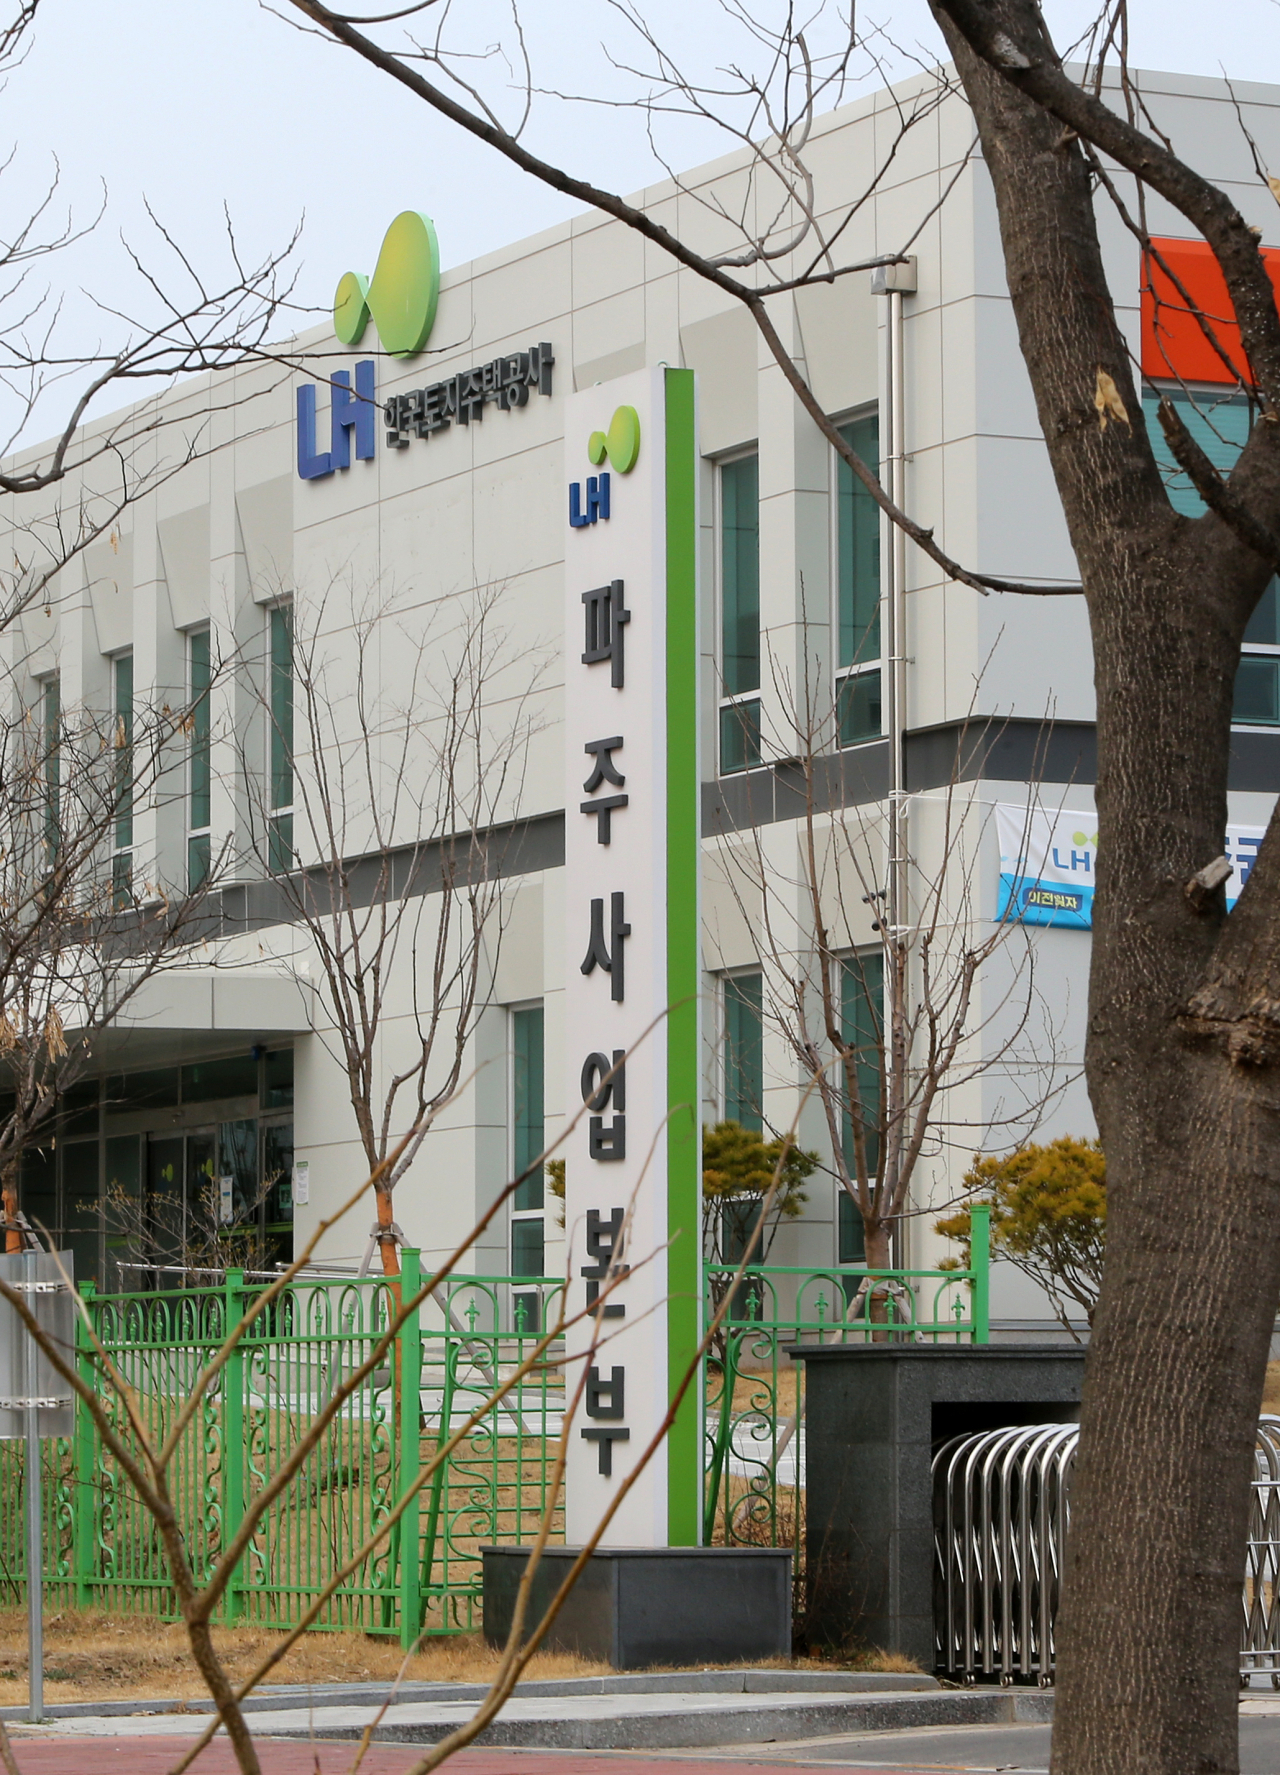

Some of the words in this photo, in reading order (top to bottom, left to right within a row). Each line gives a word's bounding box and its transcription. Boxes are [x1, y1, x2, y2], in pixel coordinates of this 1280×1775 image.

[297, 360, 375, 480] LH
[384, 342, 555, 449] 한국토지주택공사
[568, 472, 611, 529] LH
[1052, 847, 1091, 872] LH
[580, 579, 632, 1476] 파주사업본부
